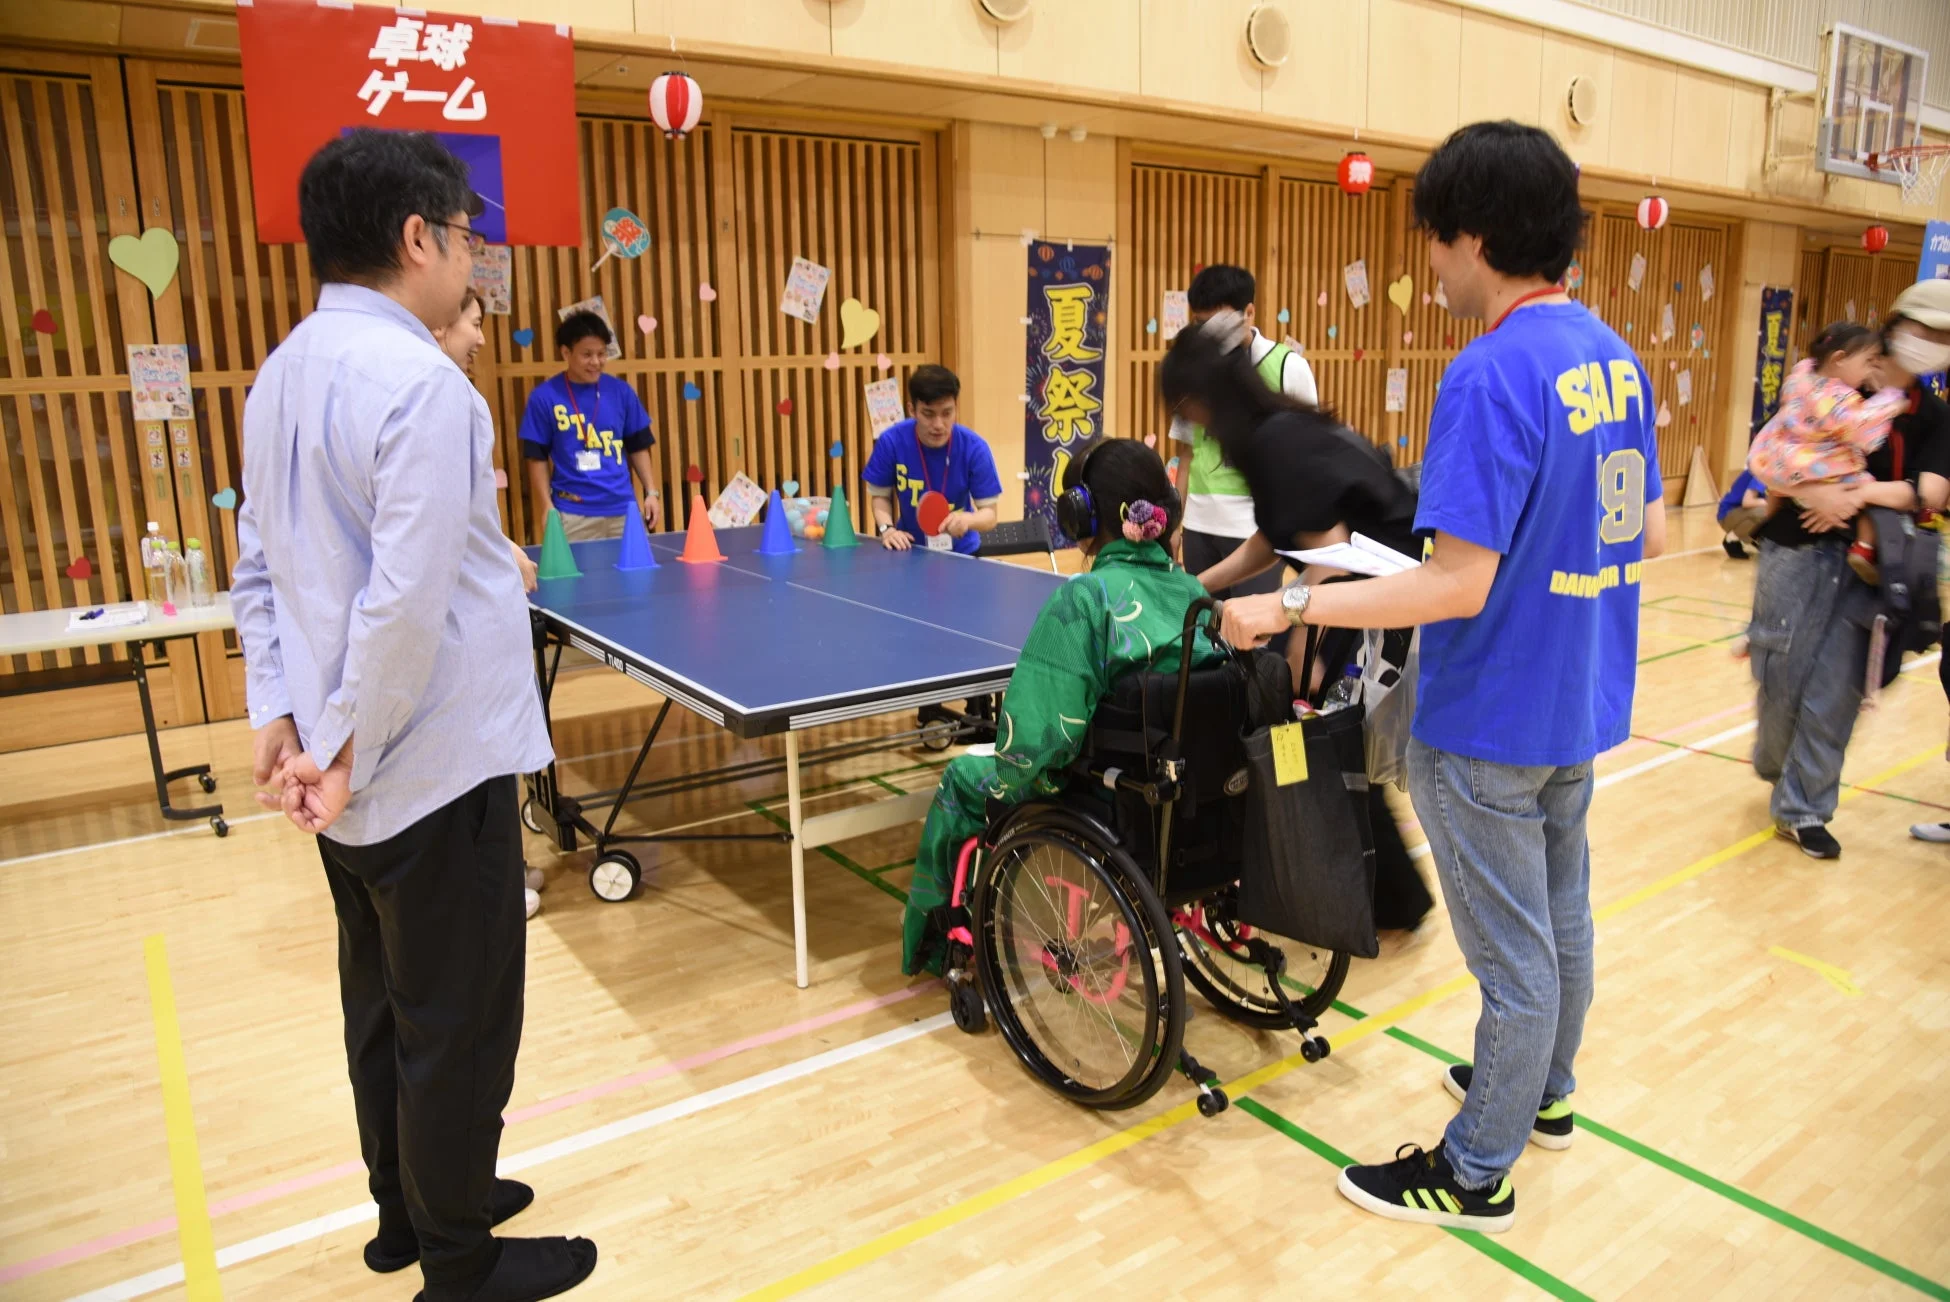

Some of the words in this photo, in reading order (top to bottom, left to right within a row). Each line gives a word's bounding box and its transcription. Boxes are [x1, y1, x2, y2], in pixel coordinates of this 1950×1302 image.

[368, 16, 473, 71] 卓球
[357, 69, 487, 121] ゲーム
[1761, 311, 1785, 421] 夏祭
